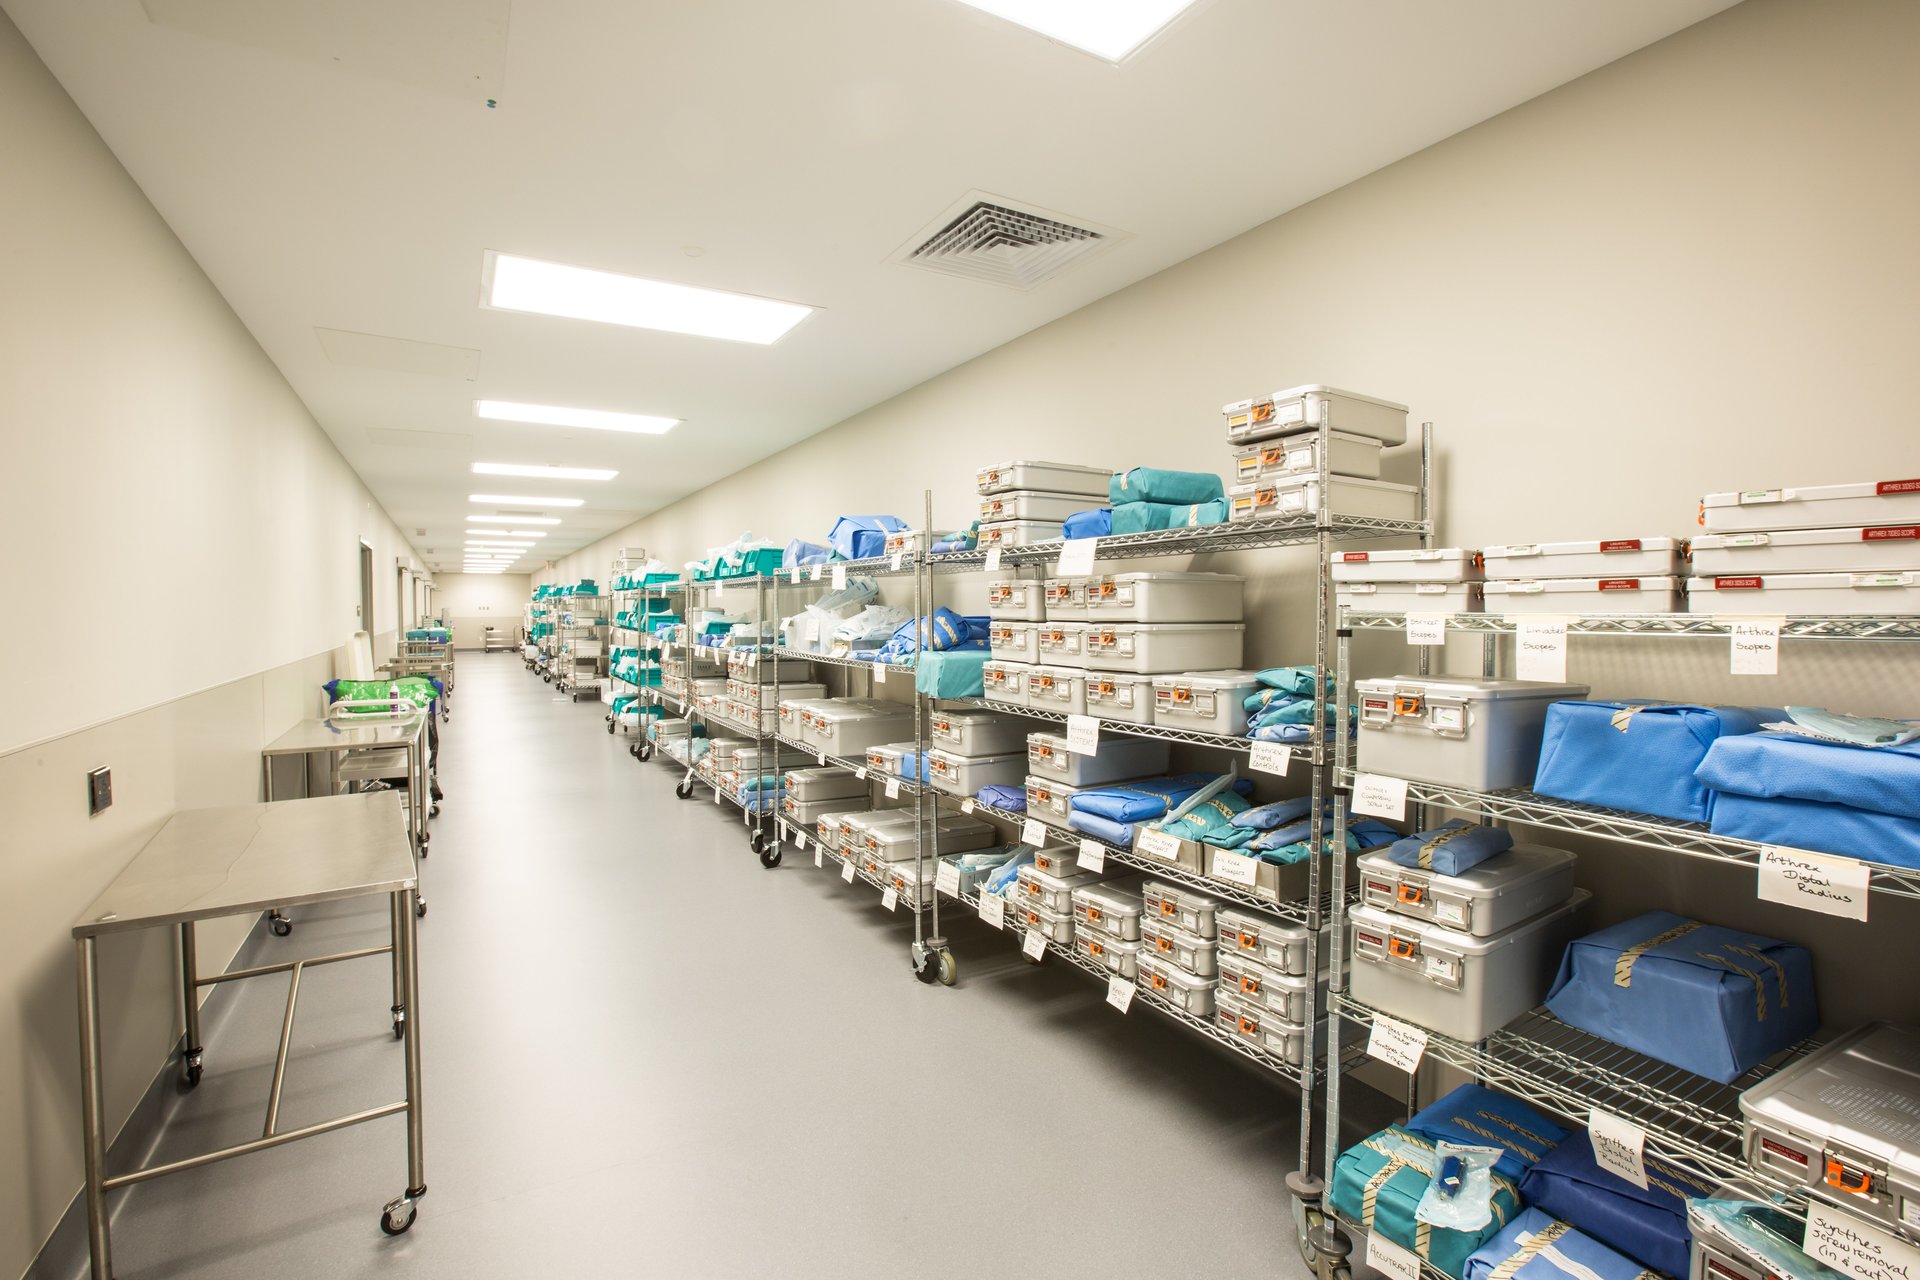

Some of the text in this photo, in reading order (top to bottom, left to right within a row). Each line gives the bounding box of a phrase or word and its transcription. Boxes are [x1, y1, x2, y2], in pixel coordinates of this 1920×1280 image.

[1868, 530, 1887, 538] ARTHREX
[1901, 529, 1916, 537] SCOPE
[1719, 579, 1734, 587] ARTHREX
[1410, 630, 1437, 639] Scopes
[1735, 625, 1776, 637] Arthrex
[1523, 641, 1556, 653] Scopes
[1736, 641, 1772, 654] Scopes
[1766, 851, 1822, 873] Arthrex
[1782, 869, 1831, 887] Distal
[1797, 882, 1853, 903] Radius
[1593, 1129, 1636, 1156] Synthes
[1853, 1247, 1910, 1280] removal
